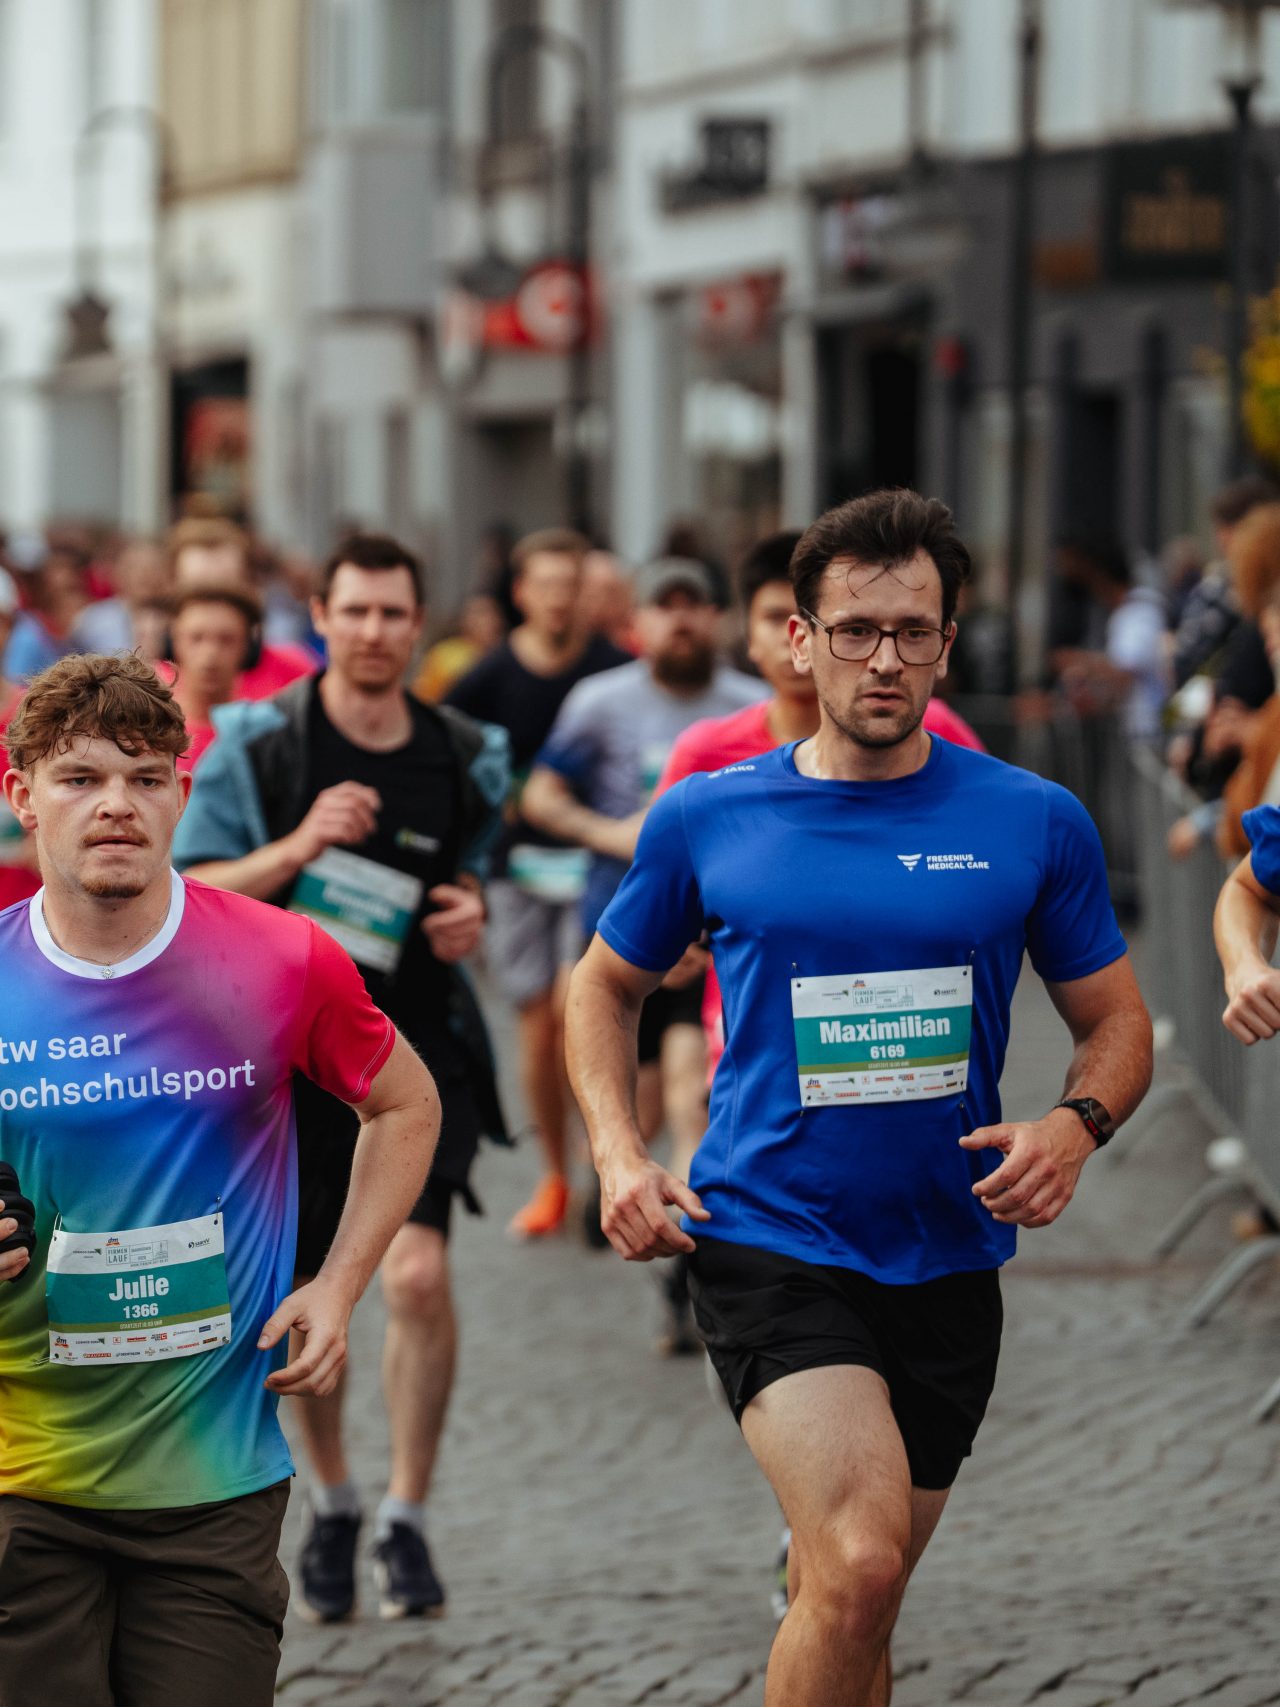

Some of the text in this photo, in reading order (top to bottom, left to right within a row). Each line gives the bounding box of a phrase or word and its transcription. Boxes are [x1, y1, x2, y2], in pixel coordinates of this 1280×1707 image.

[926, 854, 974, 863] FRESENIUS
[927, 861, 990, 871] MEDICAL CARE
[819, 1015, 951, 1044] Maximilian
[47, 1033, 127, 1060] saar
[870, 1044, 905, 1059] 6169
[108, 1255, 128, 1263] LAUF
[108, 1274, 170, 1301] Julie
[123, 1303, 159, 1319] 1366
